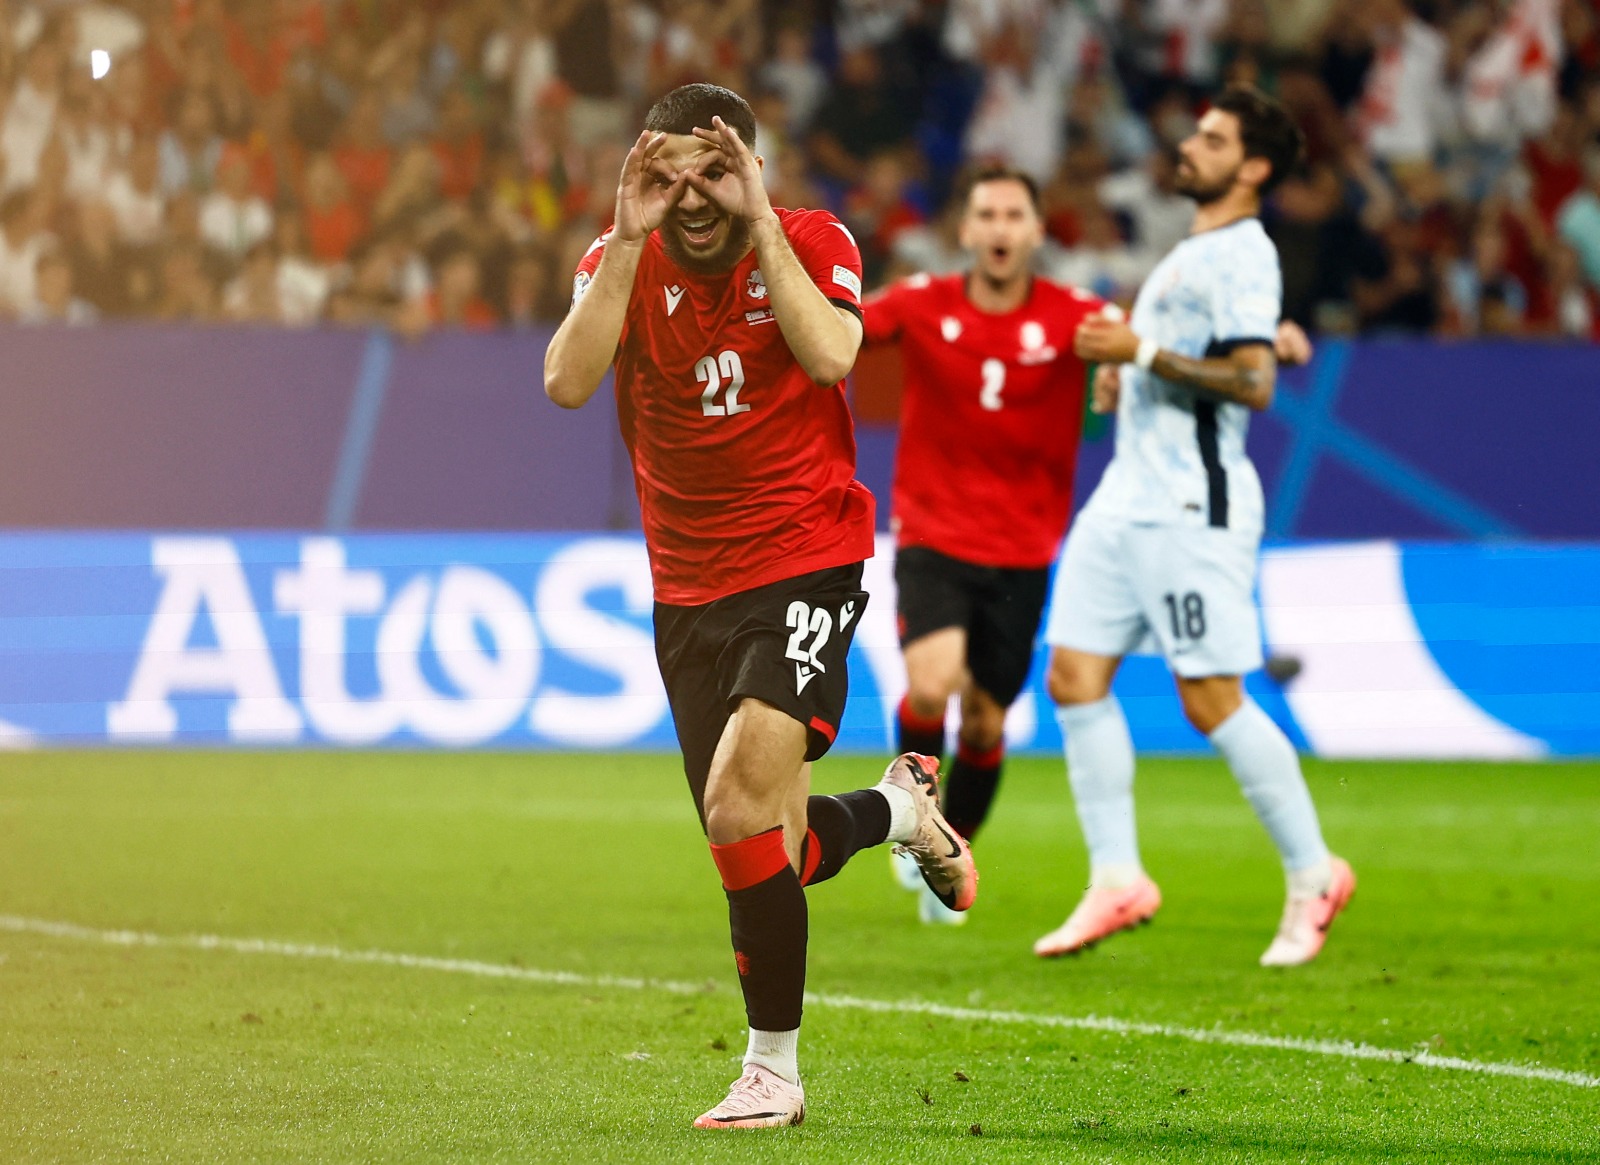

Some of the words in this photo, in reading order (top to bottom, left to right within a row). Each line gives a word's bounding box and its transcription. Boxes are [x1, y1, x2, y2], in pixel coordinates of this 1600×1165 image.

[695, 350, 750, 416] 22
[980, 358, 1006, 411] 2
[785, 600, 833, 673] 22
[1164, 591, 1206, 640] 18
